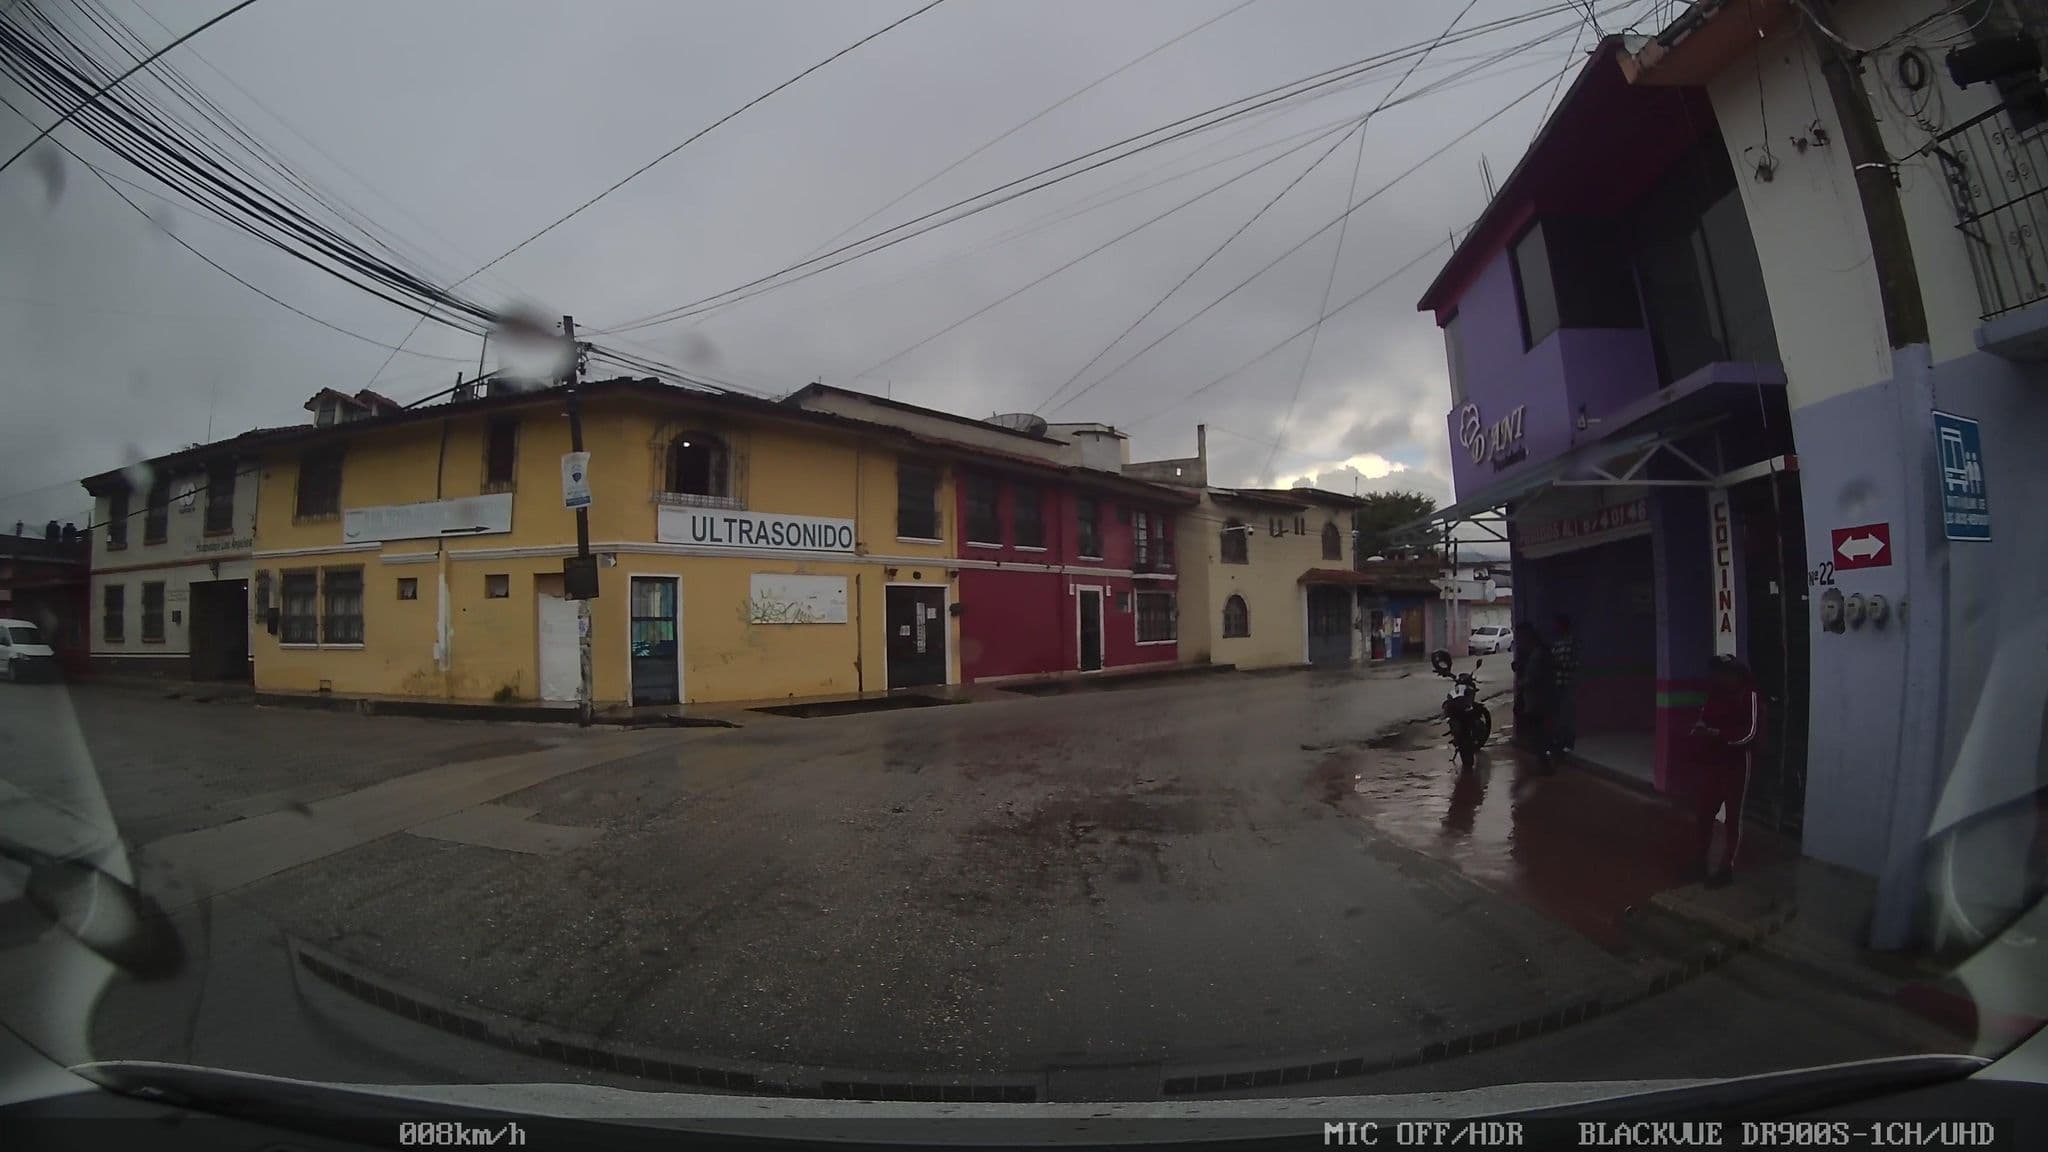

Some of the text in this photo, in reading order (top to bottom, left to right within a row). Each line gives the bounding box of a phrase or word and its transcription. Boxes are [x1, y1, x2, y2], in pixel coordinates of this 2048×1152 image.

[691, 515, 853, 549] ULTRASONIDO
[1714, 503, 1731, 632] COCINA
[1819, 561, 1835, 586] 22
